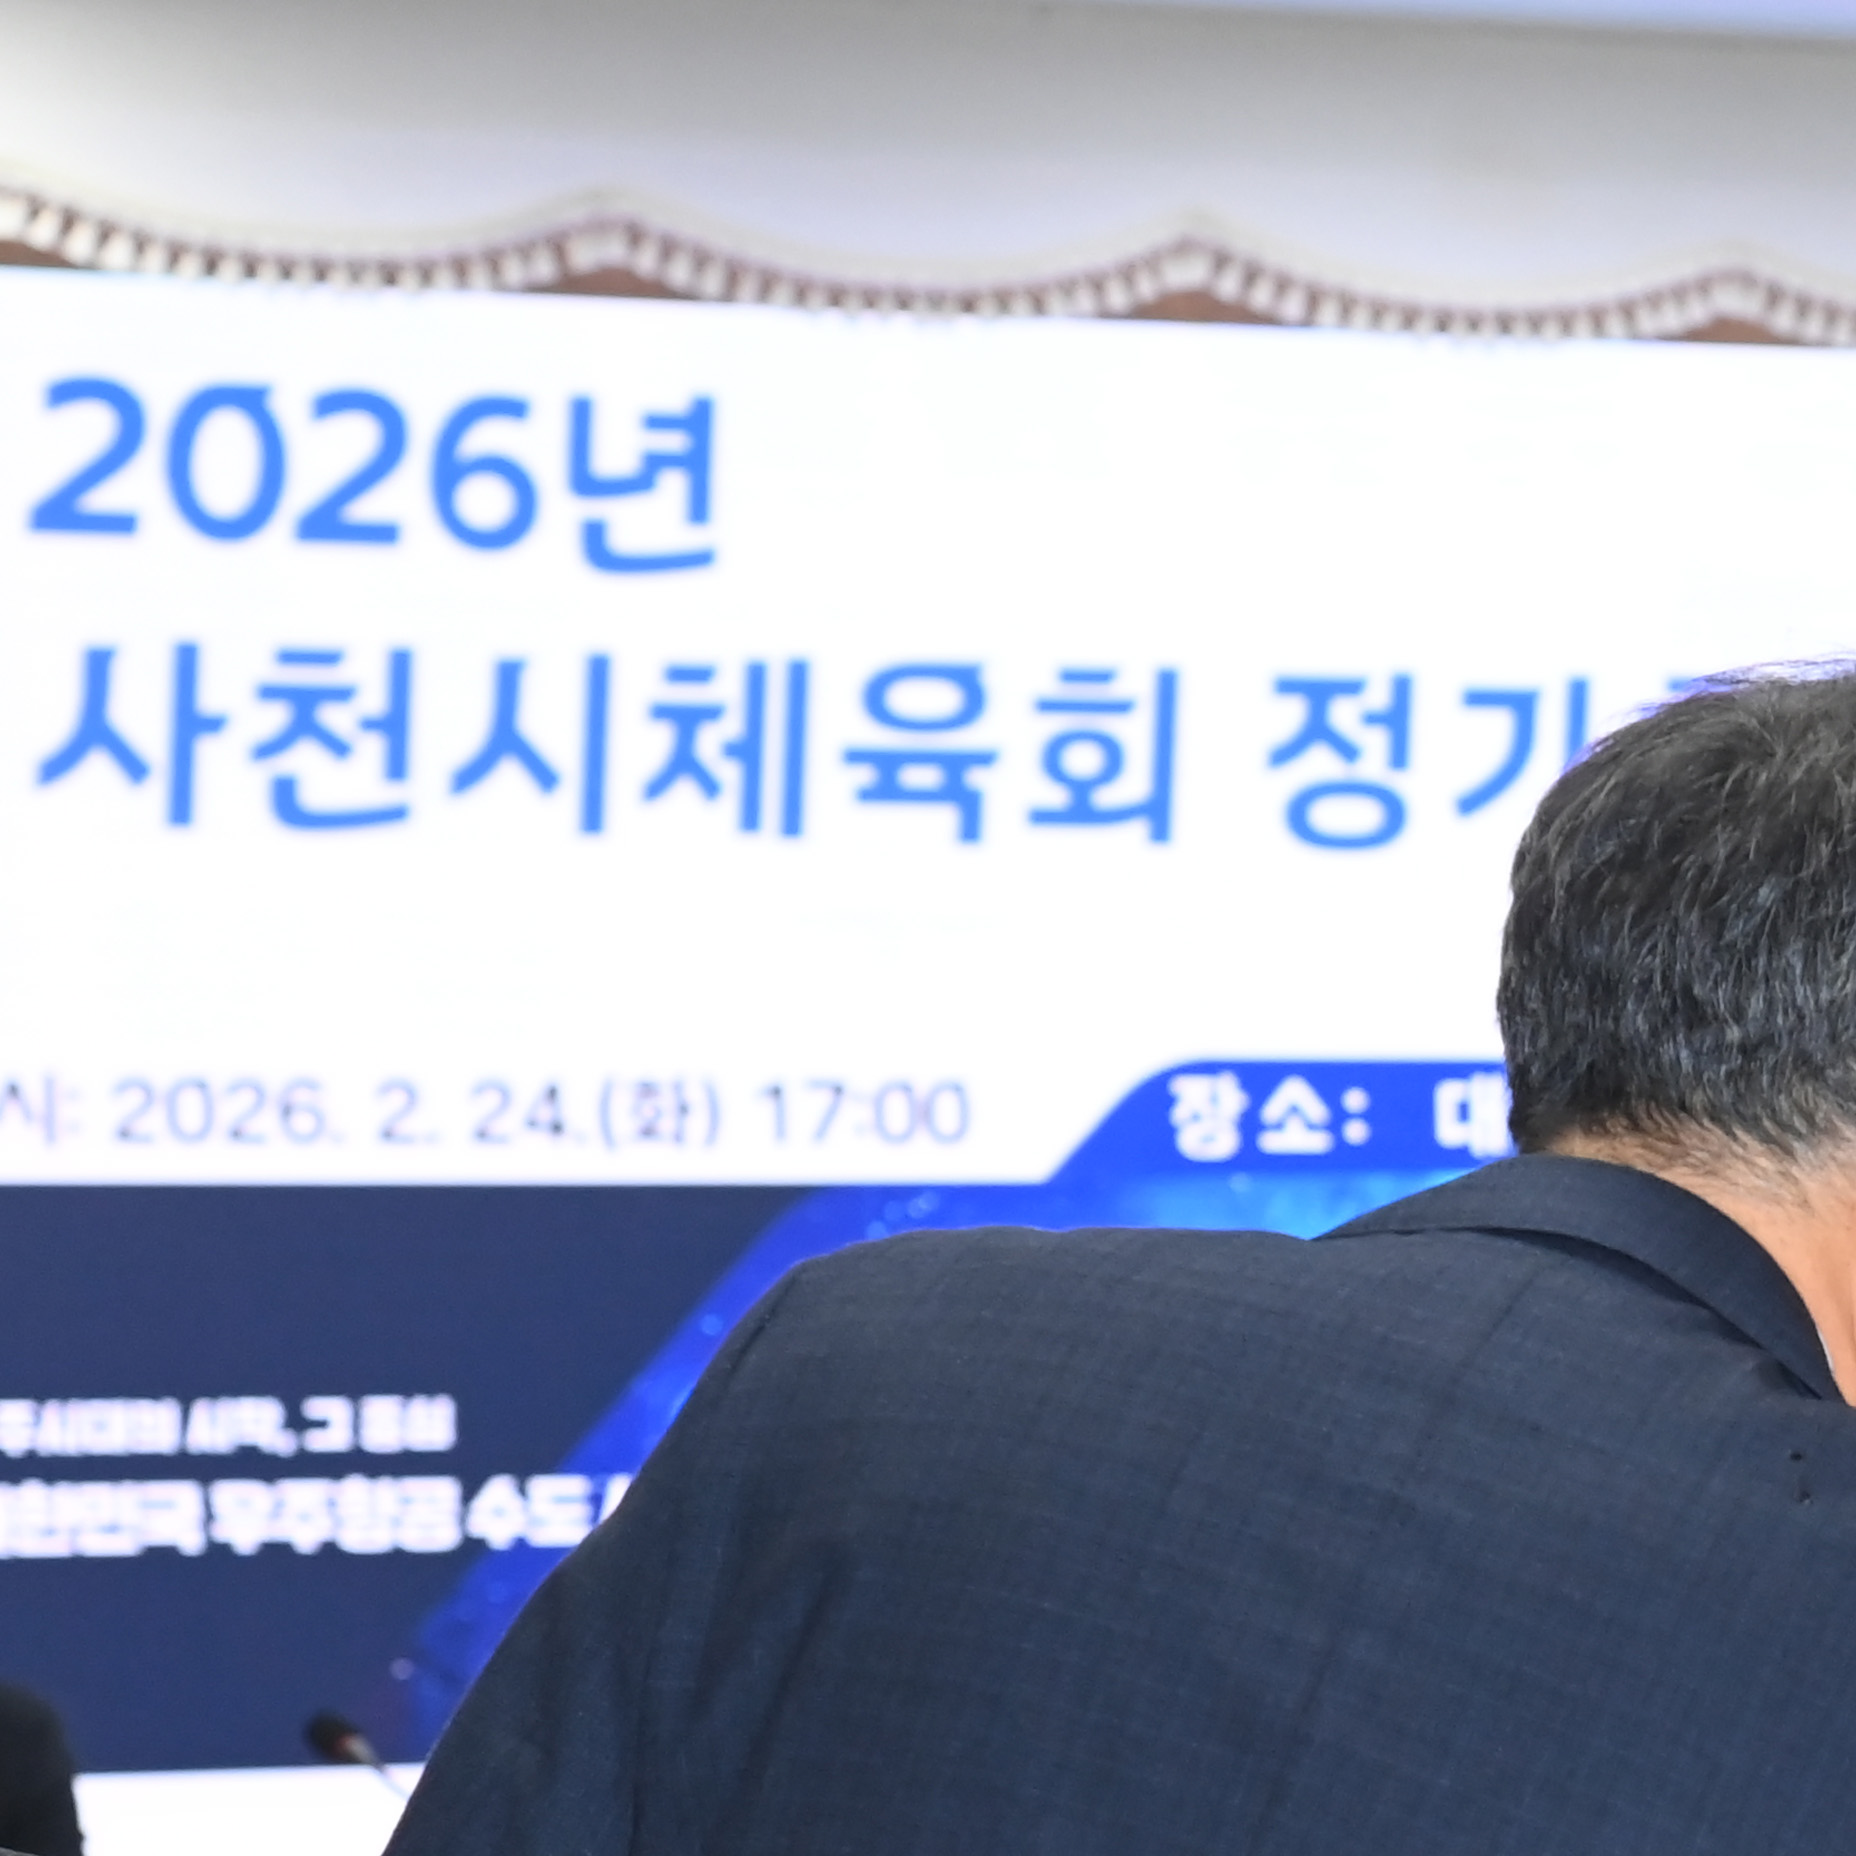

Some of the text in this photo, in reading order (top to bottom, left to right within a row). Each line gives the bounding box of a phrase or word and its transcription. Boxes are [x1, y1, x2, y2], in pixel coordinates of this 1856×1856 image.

[27, 375, 717, 575] 2026년
[36, 640, 1181, 846] 사천시체육회
[111, 1075, 344, 1147] 2026.
[757, 1076, 974, 1147] 17:00
[1168, 1071, 1371, 1161] 장소:
